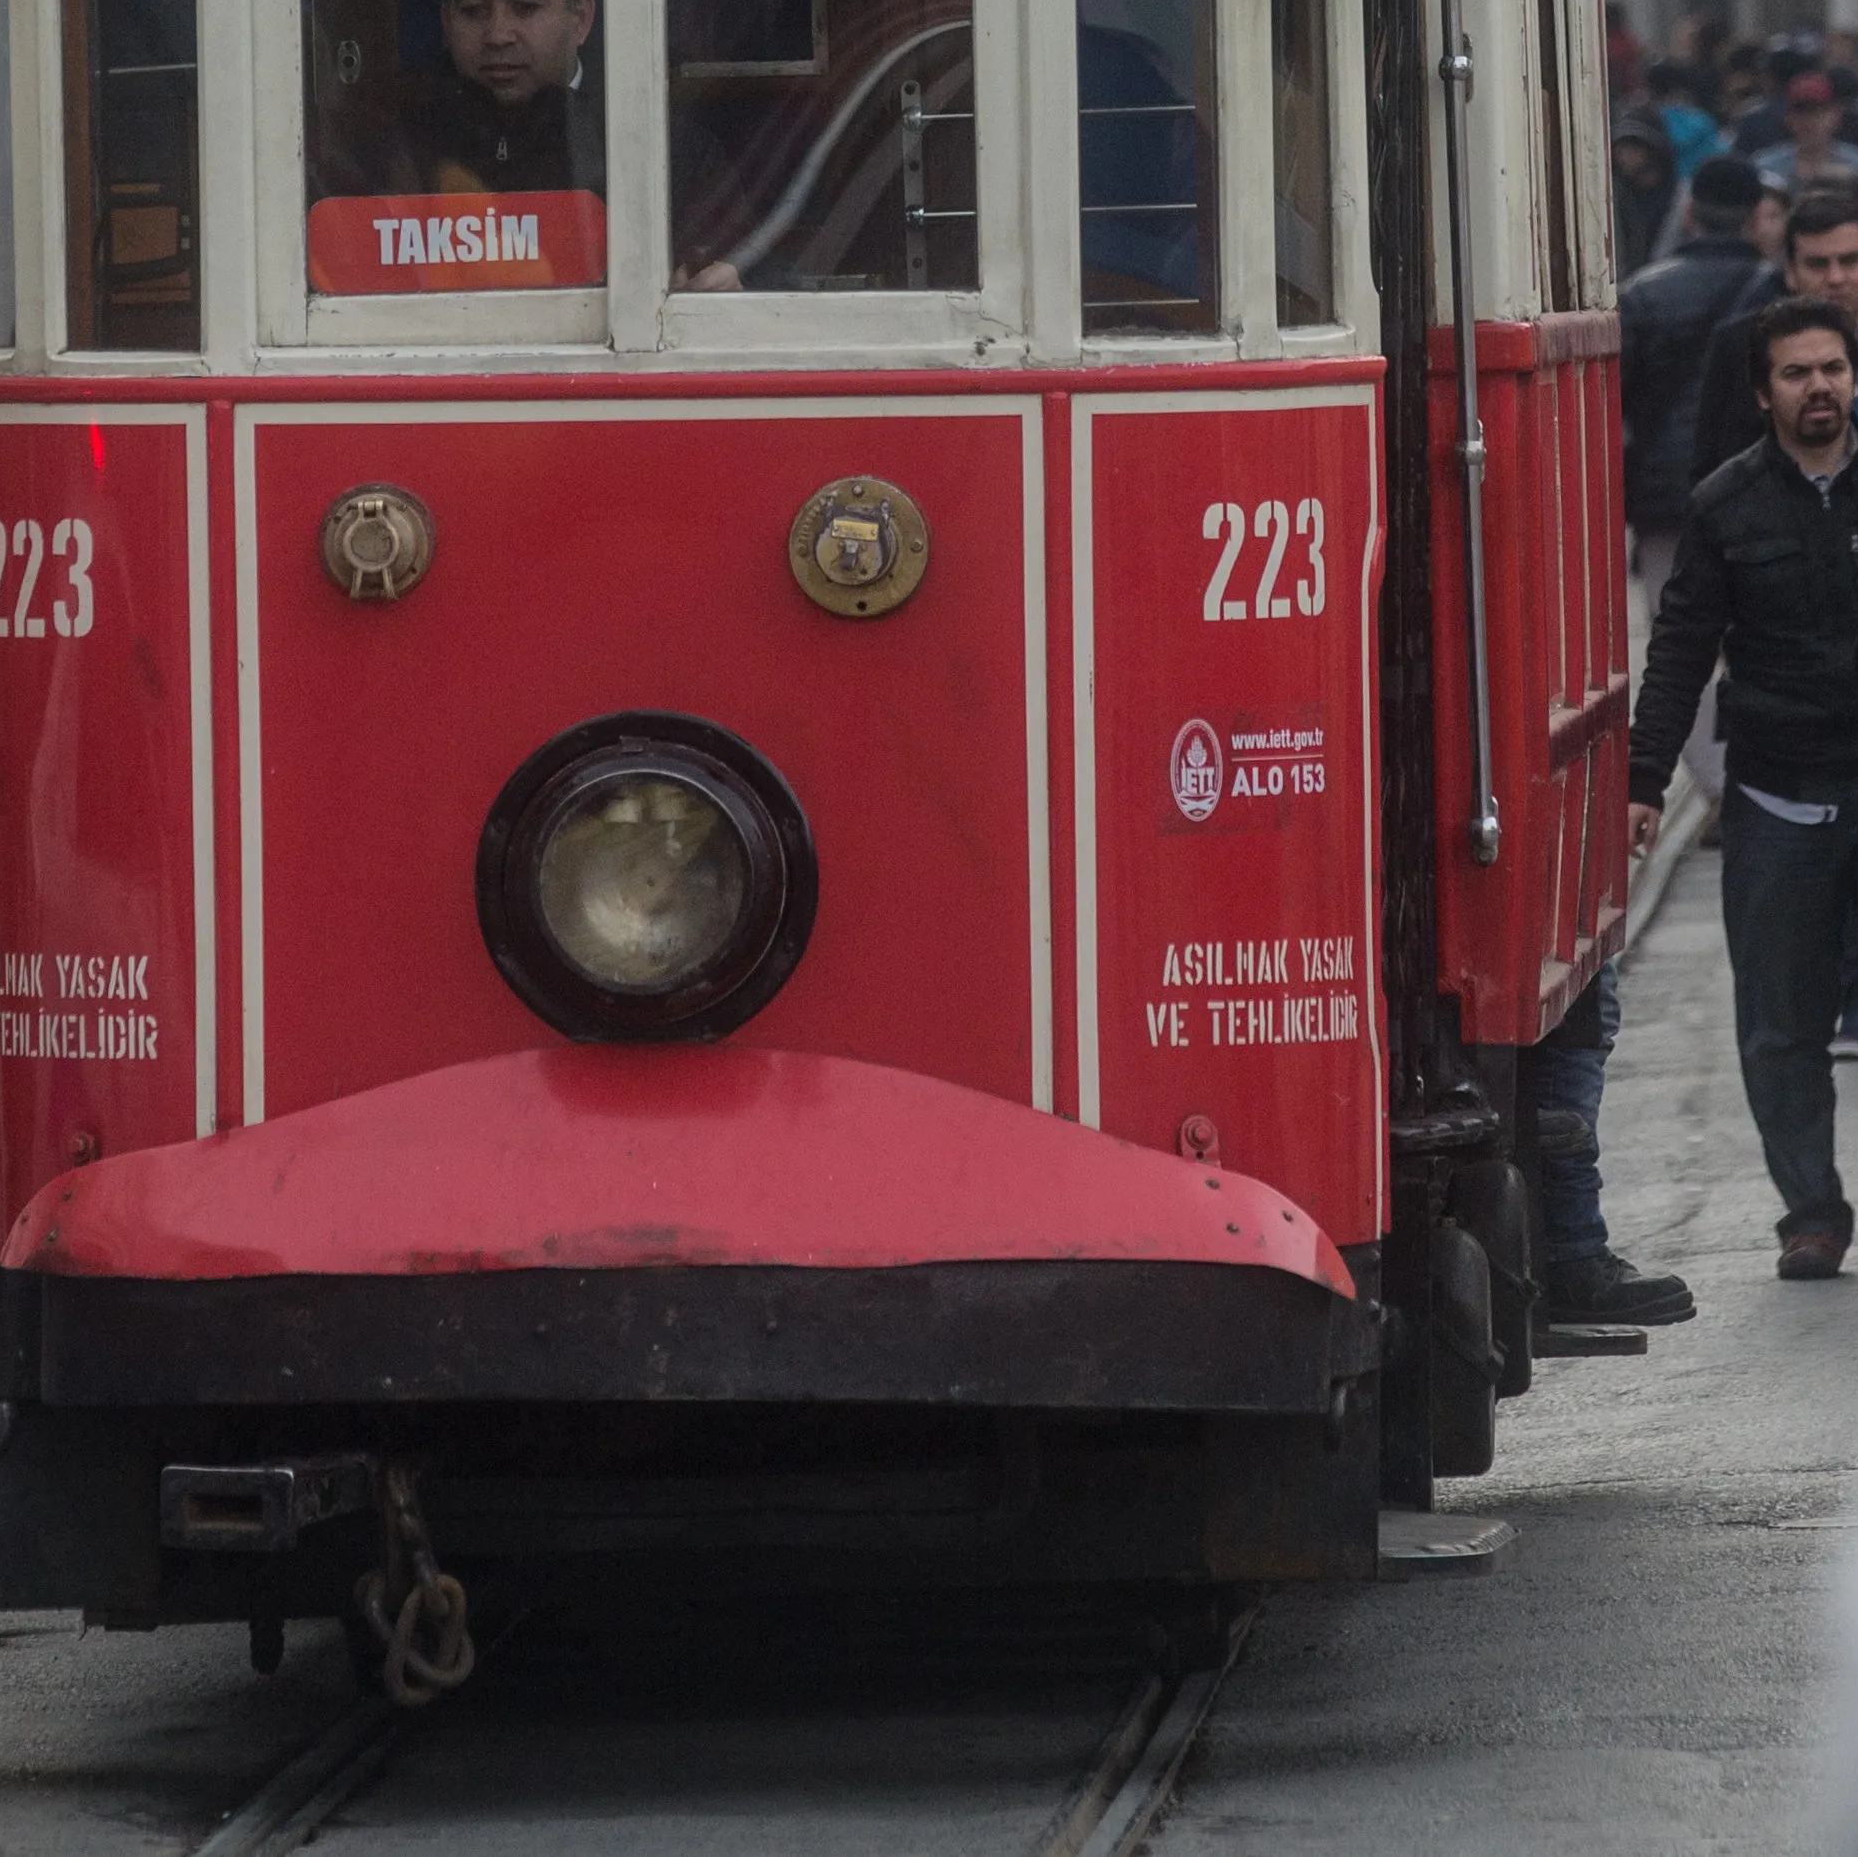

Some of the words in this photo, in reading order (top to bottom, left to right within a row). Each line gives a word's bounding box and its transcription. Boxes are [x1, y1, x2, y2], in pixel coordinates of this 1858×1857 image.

[372, 206, 540, 265] TAKSİM
[1202, 497, 1326, 621] 223
[1231, 727, 1324, 752] www.iett.gov.tr
[1231, 765, 1284, 798] ALO
[1290, 762, 1326, 794] 153
[55, 954, 149, 1000] YASAK
[1162, 939, 1289, 987] ASILMAK
[1299, 935, 1354, 983] YASAK
[1146, 1001, 1189, 1047] VE
